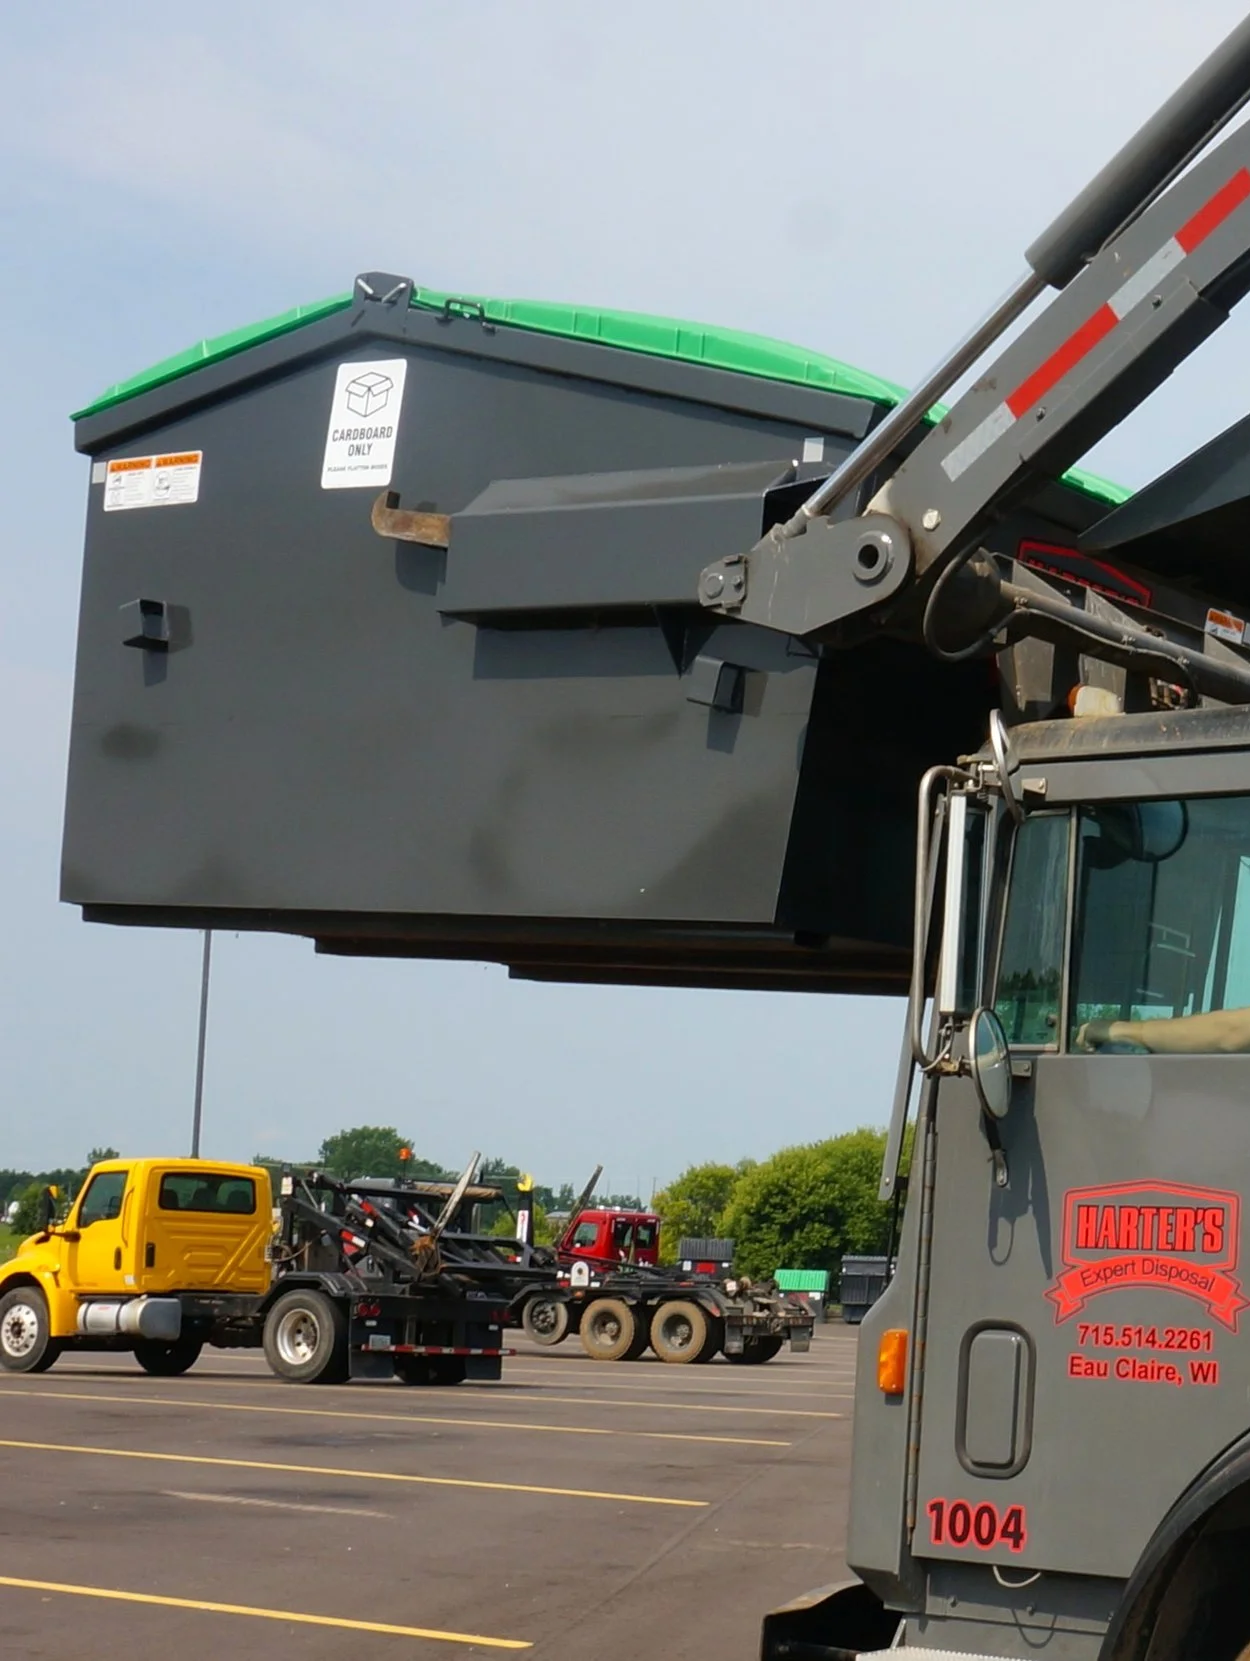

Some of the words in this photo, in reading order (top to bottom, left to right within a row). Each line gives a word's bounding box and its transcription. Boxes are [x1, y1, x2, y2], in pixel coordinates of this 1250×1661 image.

[332, 426, 393, 442] CARDBOARD
[348, 443, 373, 457] ONLY
[1076, 1204, 1225, 1254] HARTER'S
[1080, 1259, 1136, 1288] Expert
[1142, 1258, 1216, 1293] Disposal
[1077, 1324, 1213, 1352] 715.514.2261
[1068, 1355, 1109, 1377] Eau
[1115, 1357, 1183, 1386] Claire,
[1189, 1361, 1219, 1384] WI
[927, 1498, 1026, 1552] 1004
